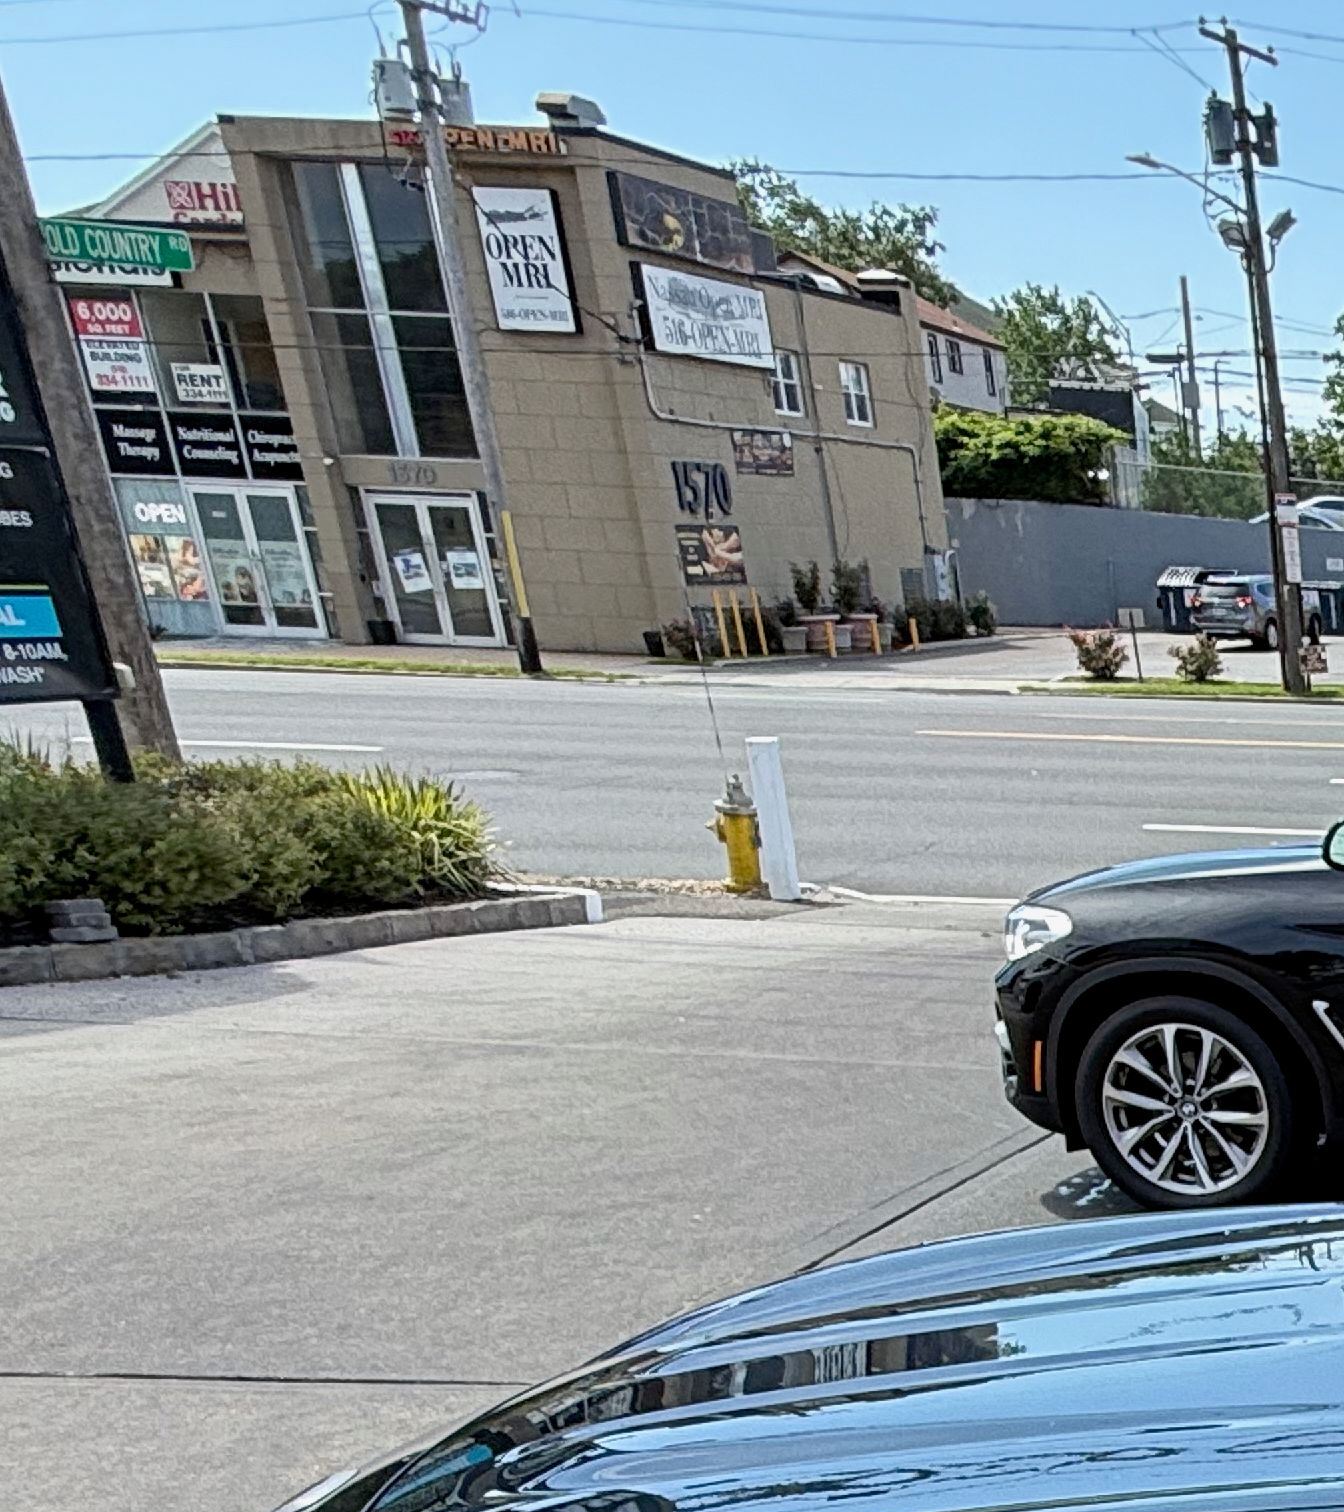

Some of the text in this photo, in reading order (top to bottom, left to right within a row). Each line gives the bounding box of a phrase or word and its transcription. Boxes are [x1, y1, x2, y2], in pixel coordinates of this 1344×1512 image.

[45, 224, 188, 264] OLD COUNTRY RD
[486, 232, 557, 262] OPEN
[499, 262, 556, 289] MRI
[77, 301, 132, 323] 6,000
[176, 372, 222, 388] RENT
[670, 460, 732, 521] 1570
[134, 502, 187, 524] OPEN
